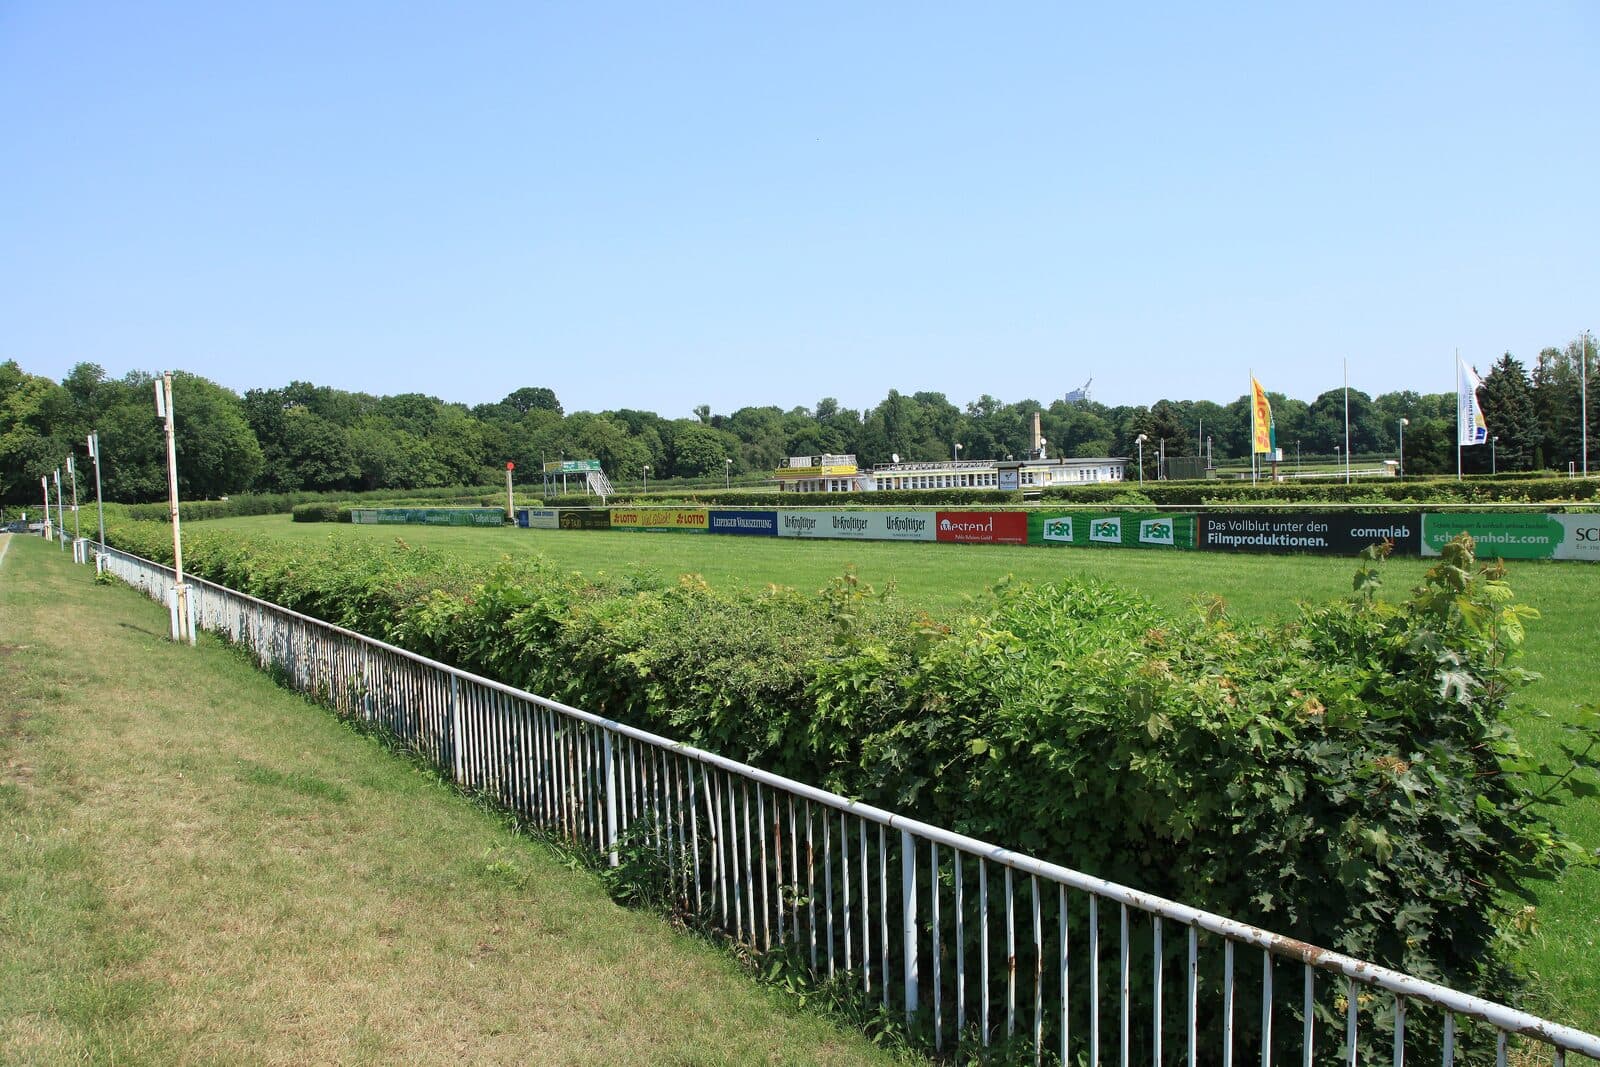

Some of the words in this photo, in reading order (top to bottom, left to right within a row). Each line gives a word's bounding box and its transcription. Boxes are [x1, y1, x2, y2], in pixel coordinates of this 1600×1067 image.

[620, 514, 637, 523] LOTTO
[684, 514, 705, 525] LOTTO
[1208, 520, 1226, 531] Das
[1228, 520, 1270, 532] Vollblut
[1273, 522, 1304, 532] unter
[1307, 521, 1328, 532] den
[1049, 522, 1070, 537] PSR
[1095, 523, 1119, 538] PSR
[1145, 524, 1171, 539] PSR
[1350, 525, 1410, 538] commlab
[1575, 527, 1600, 542] SC
[1207, 533, 1329, 548] Filmproduktionen.
